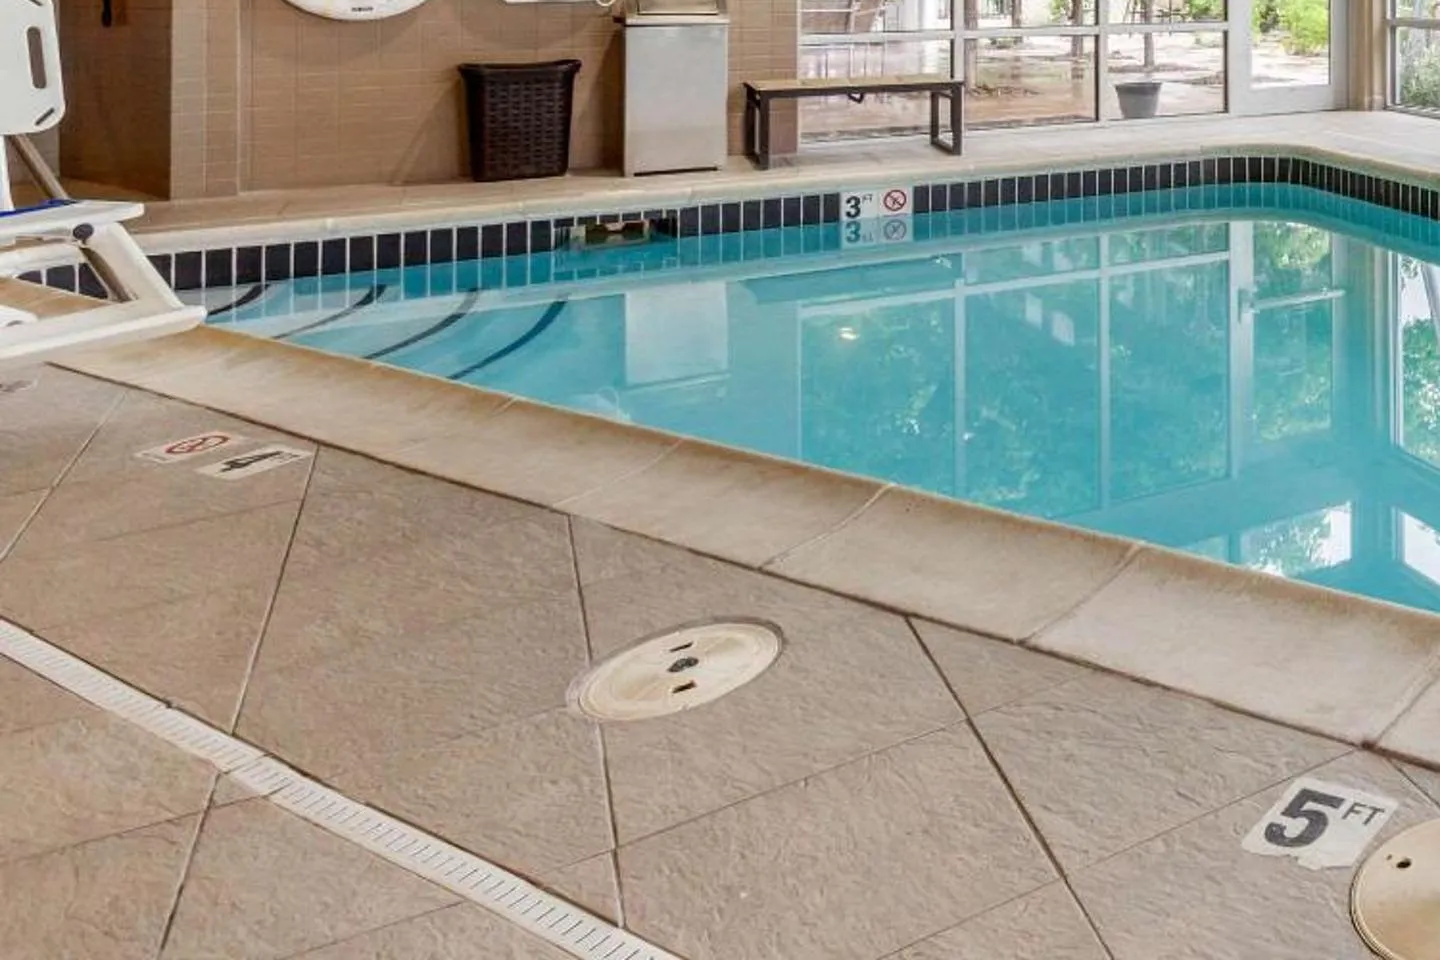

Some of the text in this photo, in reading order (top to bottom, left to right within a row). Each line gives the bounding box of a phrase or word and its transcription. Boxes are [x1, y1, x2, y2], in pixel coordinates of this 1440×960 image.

[845, 196, 861, 219] 3
[1264, 788, 1385, 848] 5 FT
